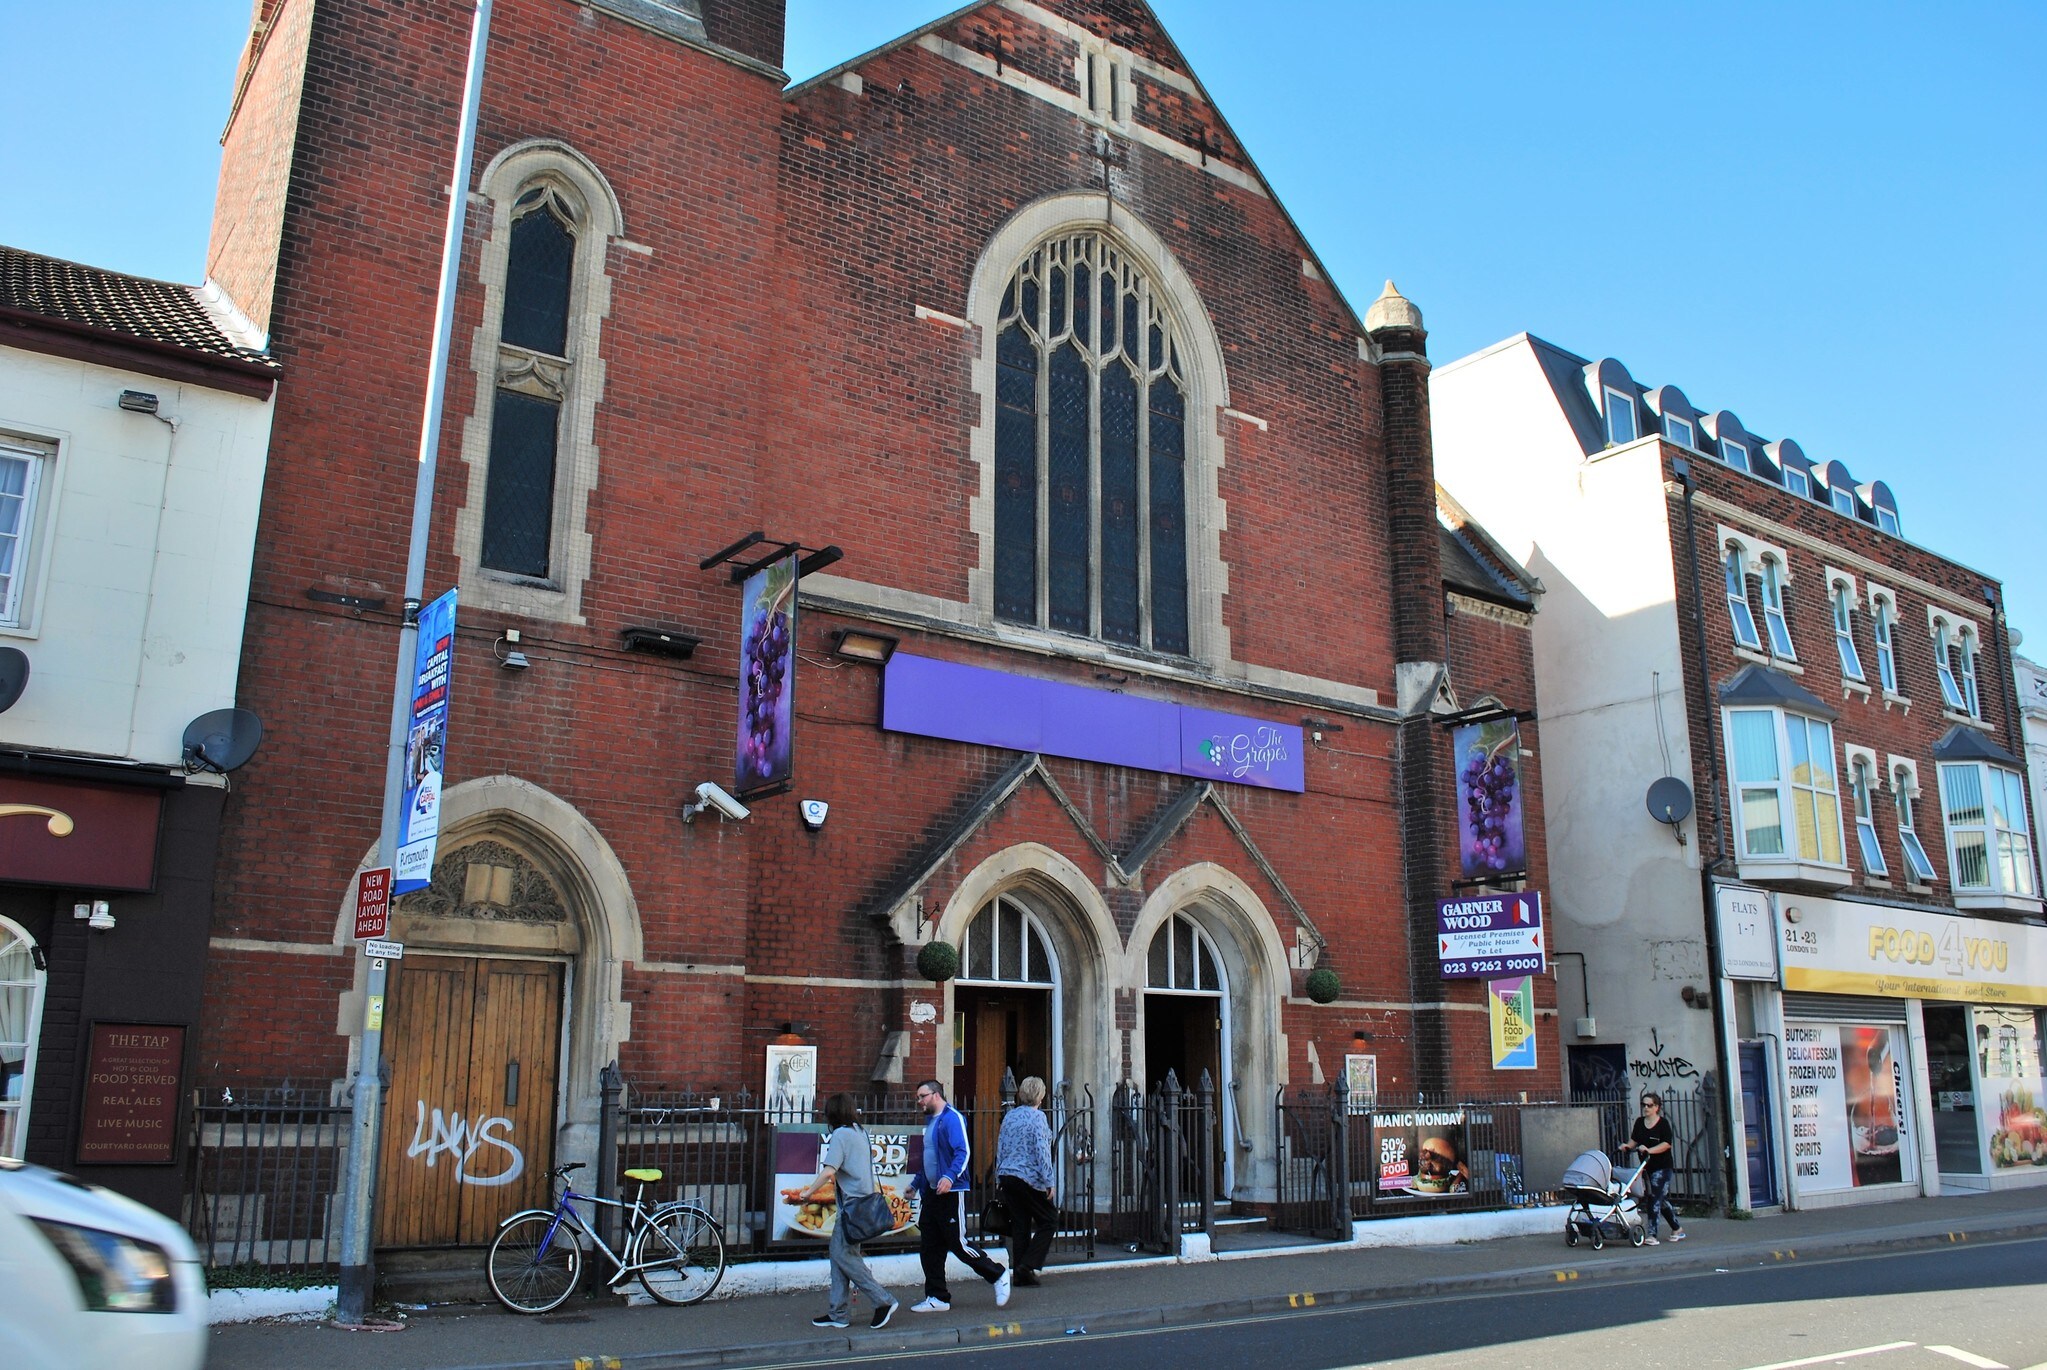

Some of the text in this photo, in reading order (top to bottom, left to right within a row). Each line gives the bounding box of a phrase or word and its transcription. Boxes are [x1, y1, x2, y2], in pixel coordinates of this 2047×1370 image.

[427, 649, 448, 670] CAPITAL
[418, 661, 448, 686] BREAKFAST
[431, 673, 447, 690] WITH
[1253, 726, 1282, 748] The
[1230, 734, 1288, 778] Grapes
[366, 874, 384, 888] NEW
[363, 889, 383, 902] ROAD
[358, 903, 386, 918] LAYOUT
[1442, 900, 1503, 917] GARNER
[1732, 901, 1758, 915] FLATS
[357, 919, 383, 933] AHEAD
[1443, 915, 1492, 930] WOOD
[1454, 930, 1525, 941] Licensed Premises
[379, 943, 400, 951] loading
[1468, 940, 1492, 948] Public
[1786, 944, 1809, 954] LONDON
[1869, 921, 2007, 976] FOOD 4 YOU
[375, 949, 386, 957] any
[387, 949, 400, 957] time
[375, 960, 382, 968] 4
[1444, 958, 1539, 974] 023 9262 9000
[1875, 979, 1900, 992] Your
[1902, 981, 1961, 996] International
[1985, 986, 2007, 998] Store
[1504, 996, 1521, 1006] 50%
[1506, 1007, 1521, 1016] OFF
[1504, 1017, 1518, 1026] ALL
[1504, 1027, 1523, 1035] FOOD
[1786, 1029, 1822, 1042] BUTCHERY
[109, 1034, 169, 1048] THE TAP
[1787, 1048, 1837, 1061] DELICATESSAN
[789, 1053, 810, 1072] CHER
[93, 1074, 176, 1085] FOOD SERVED
[1789, 1066, 1836, 1079] FROZEN FOOD
[1791, 1086, 1818, 1099] BAKERY
[1893, 1061, 1907, 1136] Cheers!
[103, 1096, 162, 1106] REAL ALES
[1792, 1104, 1818, 1118] DRINKS
[97, 1119, 162, 1128] LIVE MUSIC
[1373, 1112, 1463, 1128] MANIC MONDAY
[1794, 1123, 1816, 1137] BEERS
[85, 1142, 134, 1150] COURTYARD
[1381, 1138, 1406, 1151] 50%
[1795, 1142, 1822, 1157] SPIRITS
[1381, 1150, 1404, 1163] OFF
[1382, 1162, 1407, 1176] FOOD
[1796, 1161, 1819, 1177] WINES
